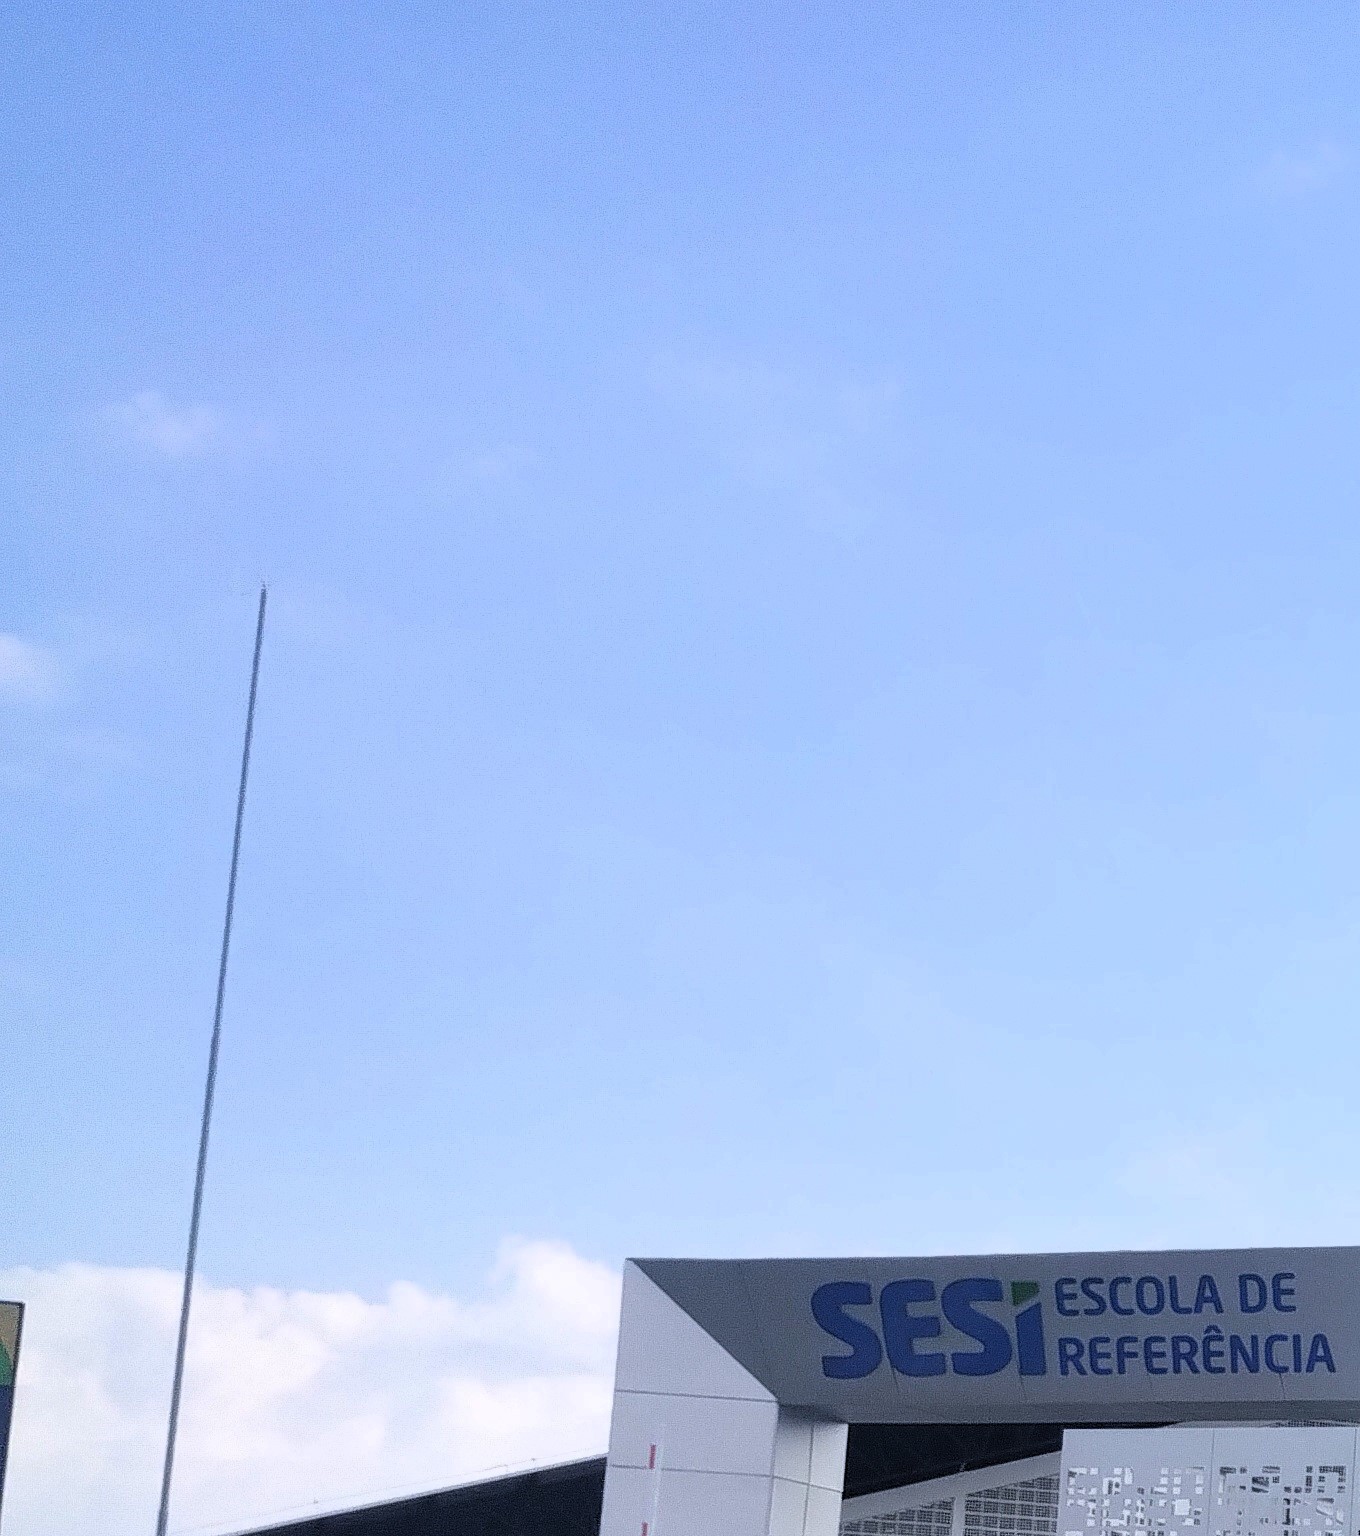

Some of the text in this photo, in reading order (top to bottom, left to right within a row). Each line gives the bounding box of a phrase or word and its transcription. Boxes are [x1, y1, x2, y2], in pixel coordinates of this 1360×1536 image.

[1054, 1272, 1298, 1317] ESCOLA DE
[1057, 1325, 1337, 1377] REFERÊNCIA
